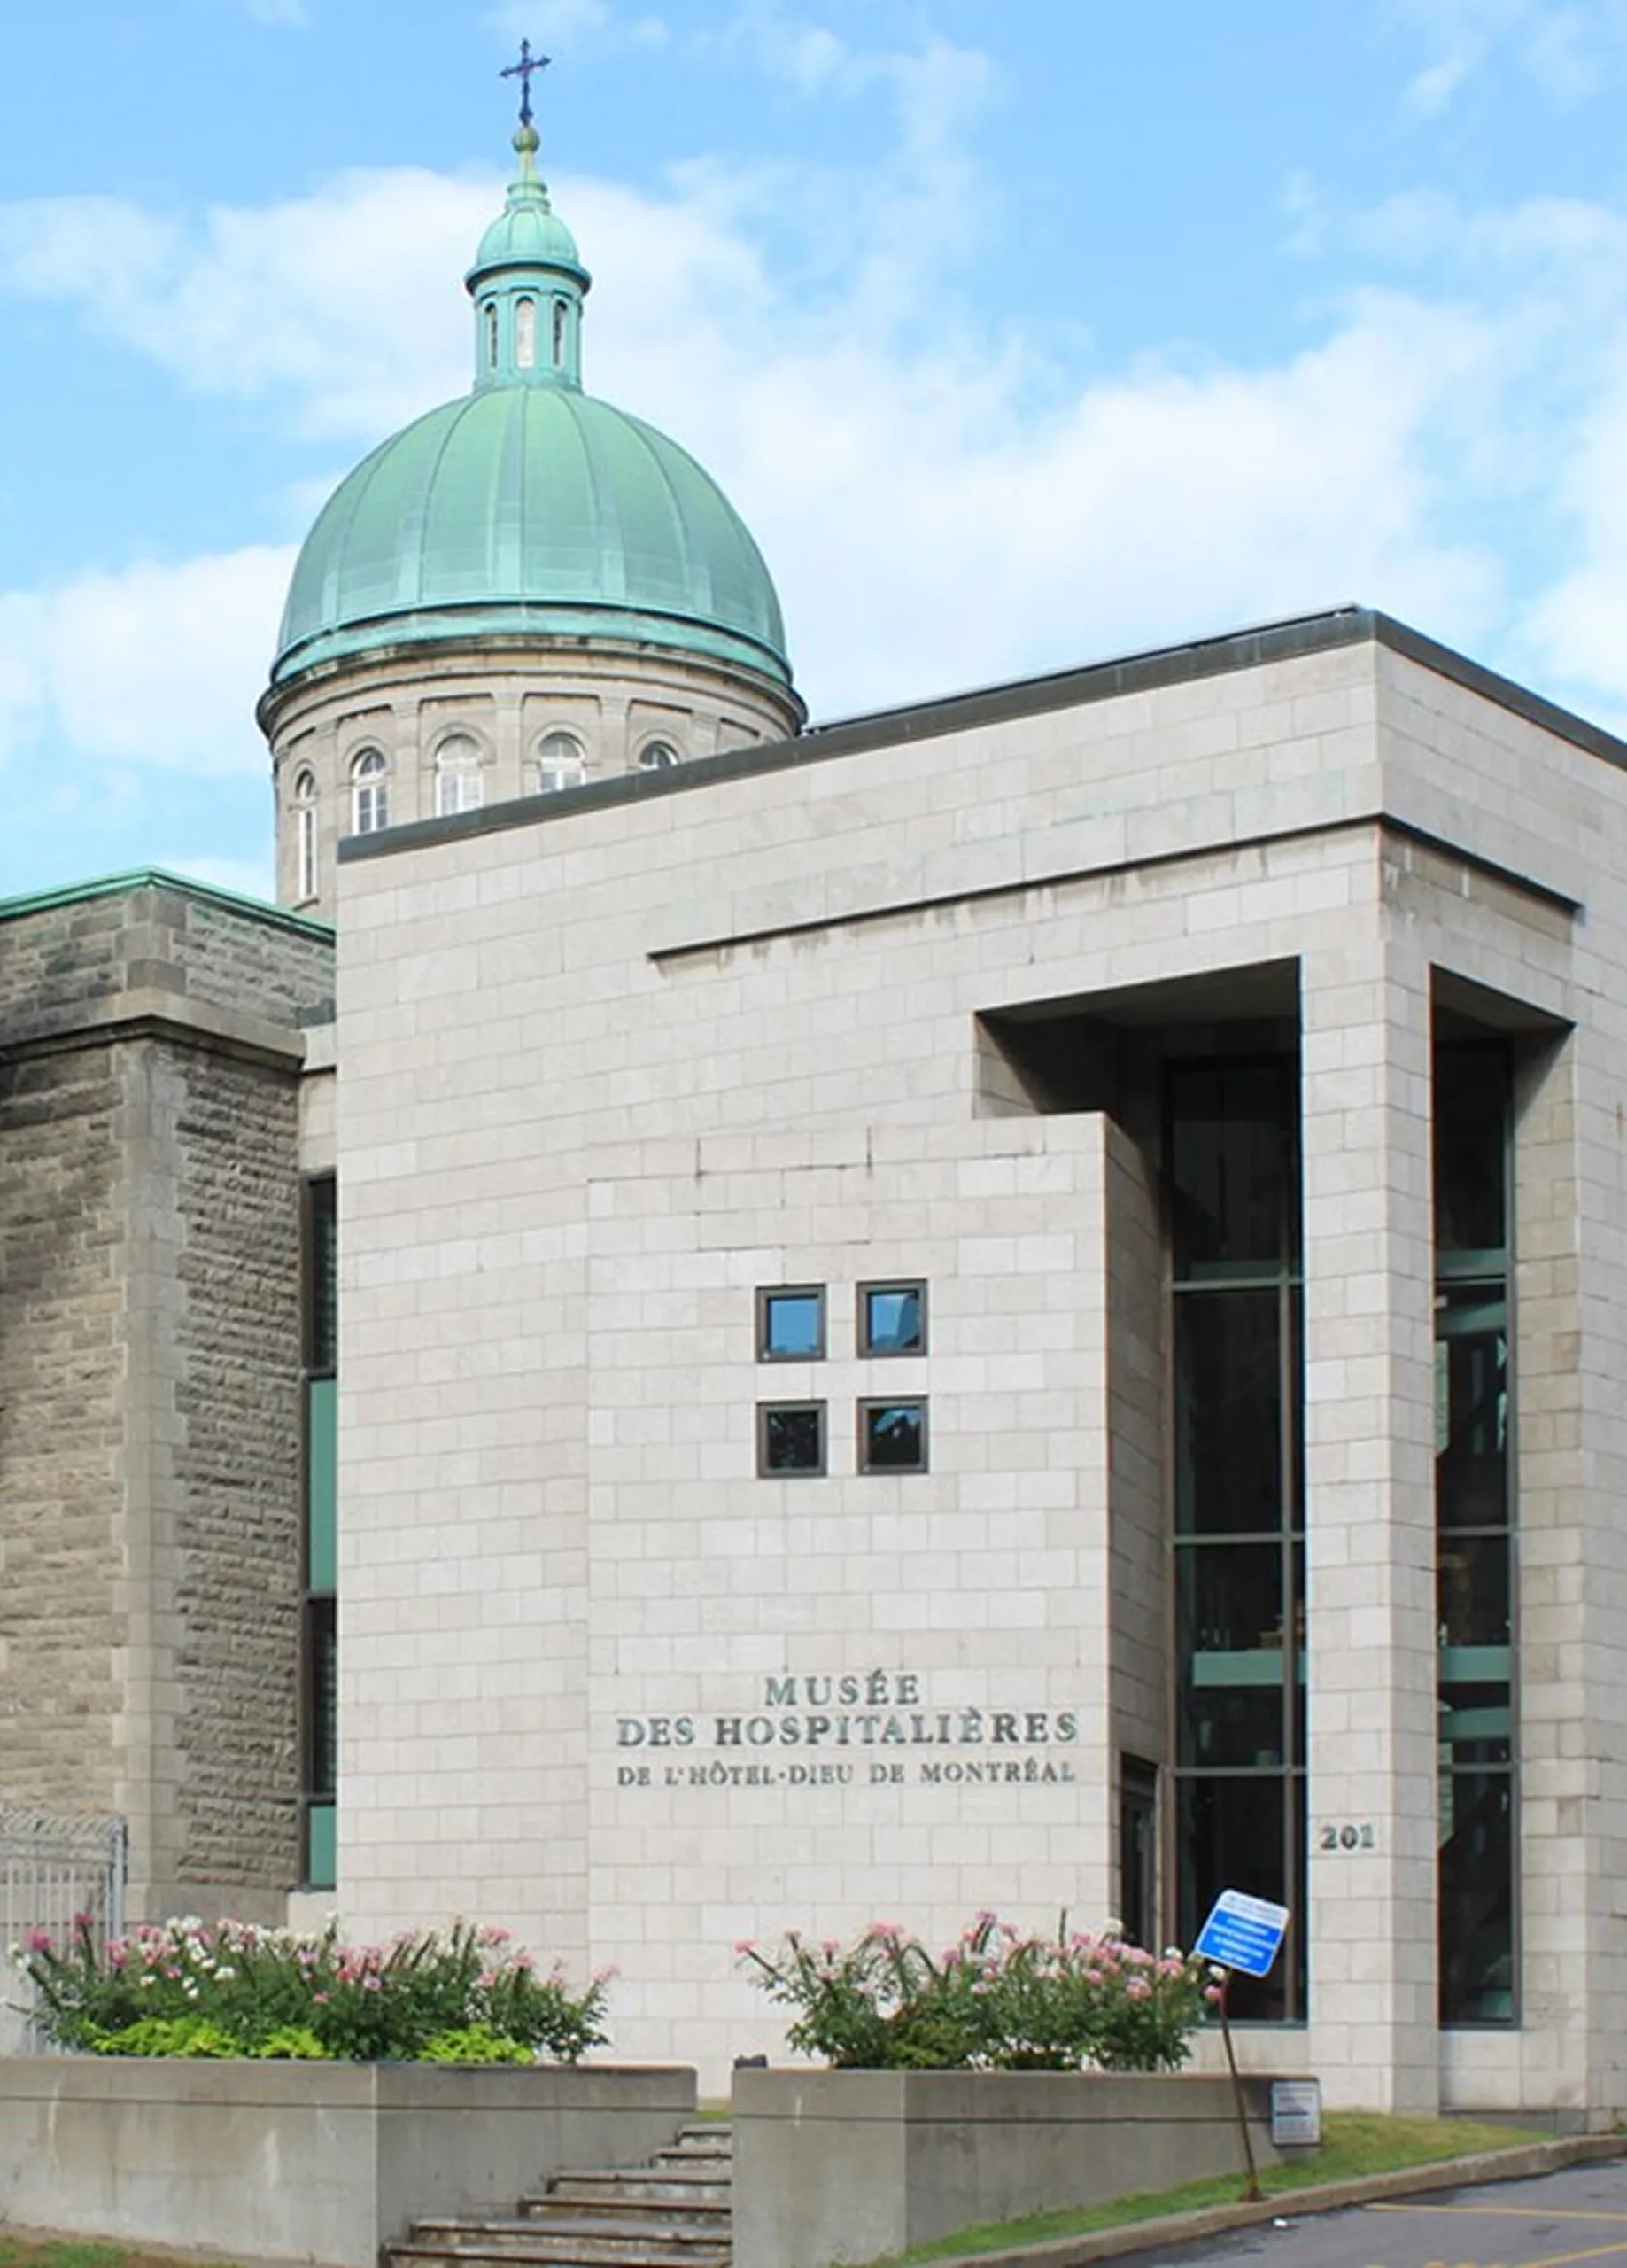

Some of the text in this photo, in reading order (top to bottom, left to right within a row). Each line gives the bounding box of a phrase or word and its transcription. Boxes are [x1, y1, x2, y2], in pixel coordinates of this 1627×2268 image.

[765, 1668, 919, 1706] MUSÉE
[617, 1706, 1078, 1747] DES HOSPITALIÈRES
[618, 1766, 651, 1786] DE
[870, 1764, 905, 1784] DE
[920, 1758, 1075, 1783] MONTRÉAL
[1321, 1823, 1374, 1850] 201
